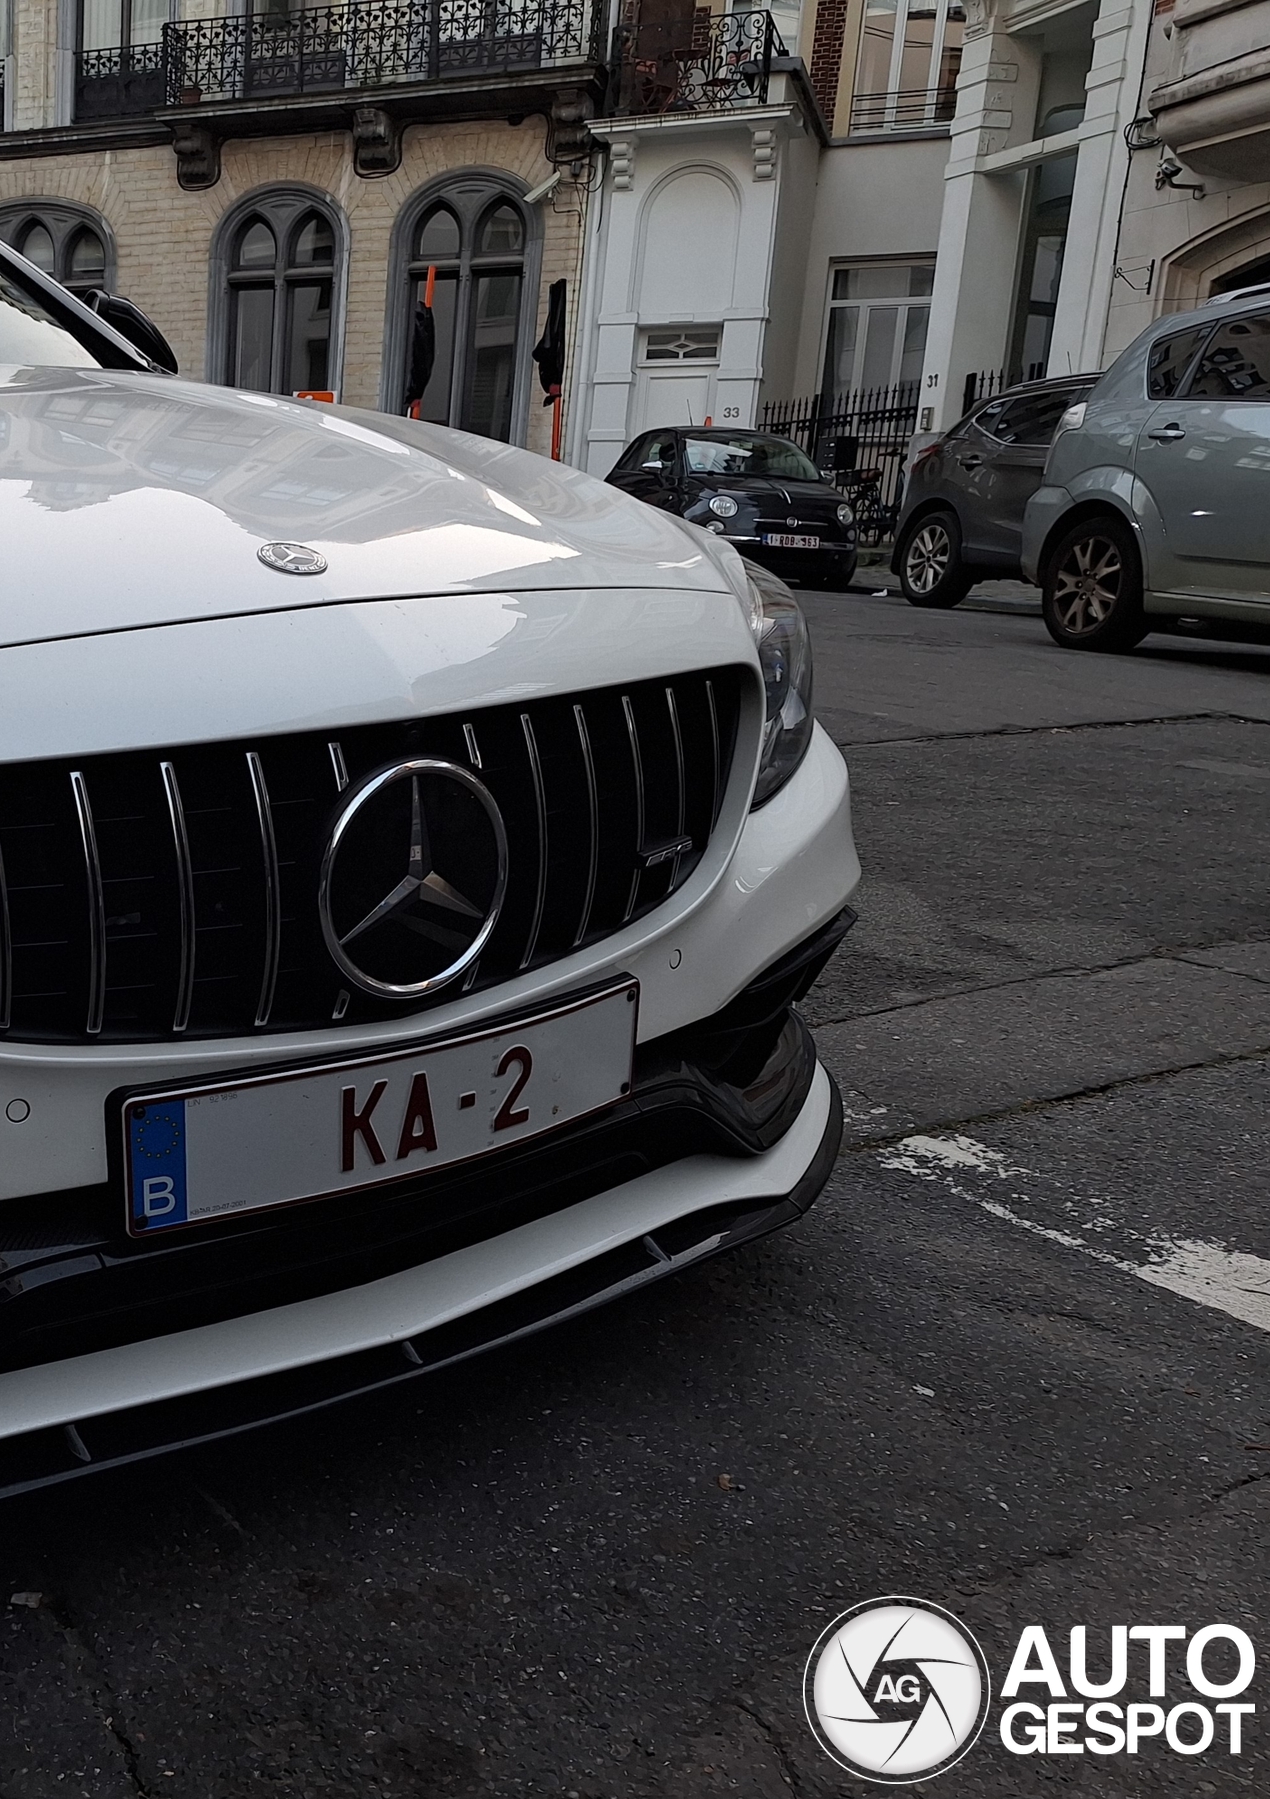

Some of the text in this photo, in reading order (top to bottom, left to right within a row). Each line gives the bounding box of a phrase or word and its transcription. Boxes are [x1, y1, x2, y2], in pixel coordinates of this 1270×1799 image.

[926, 374, 939, 388] 31
[723, 406, 740, 419] 33
[143, 1176, 176, 1217] B
